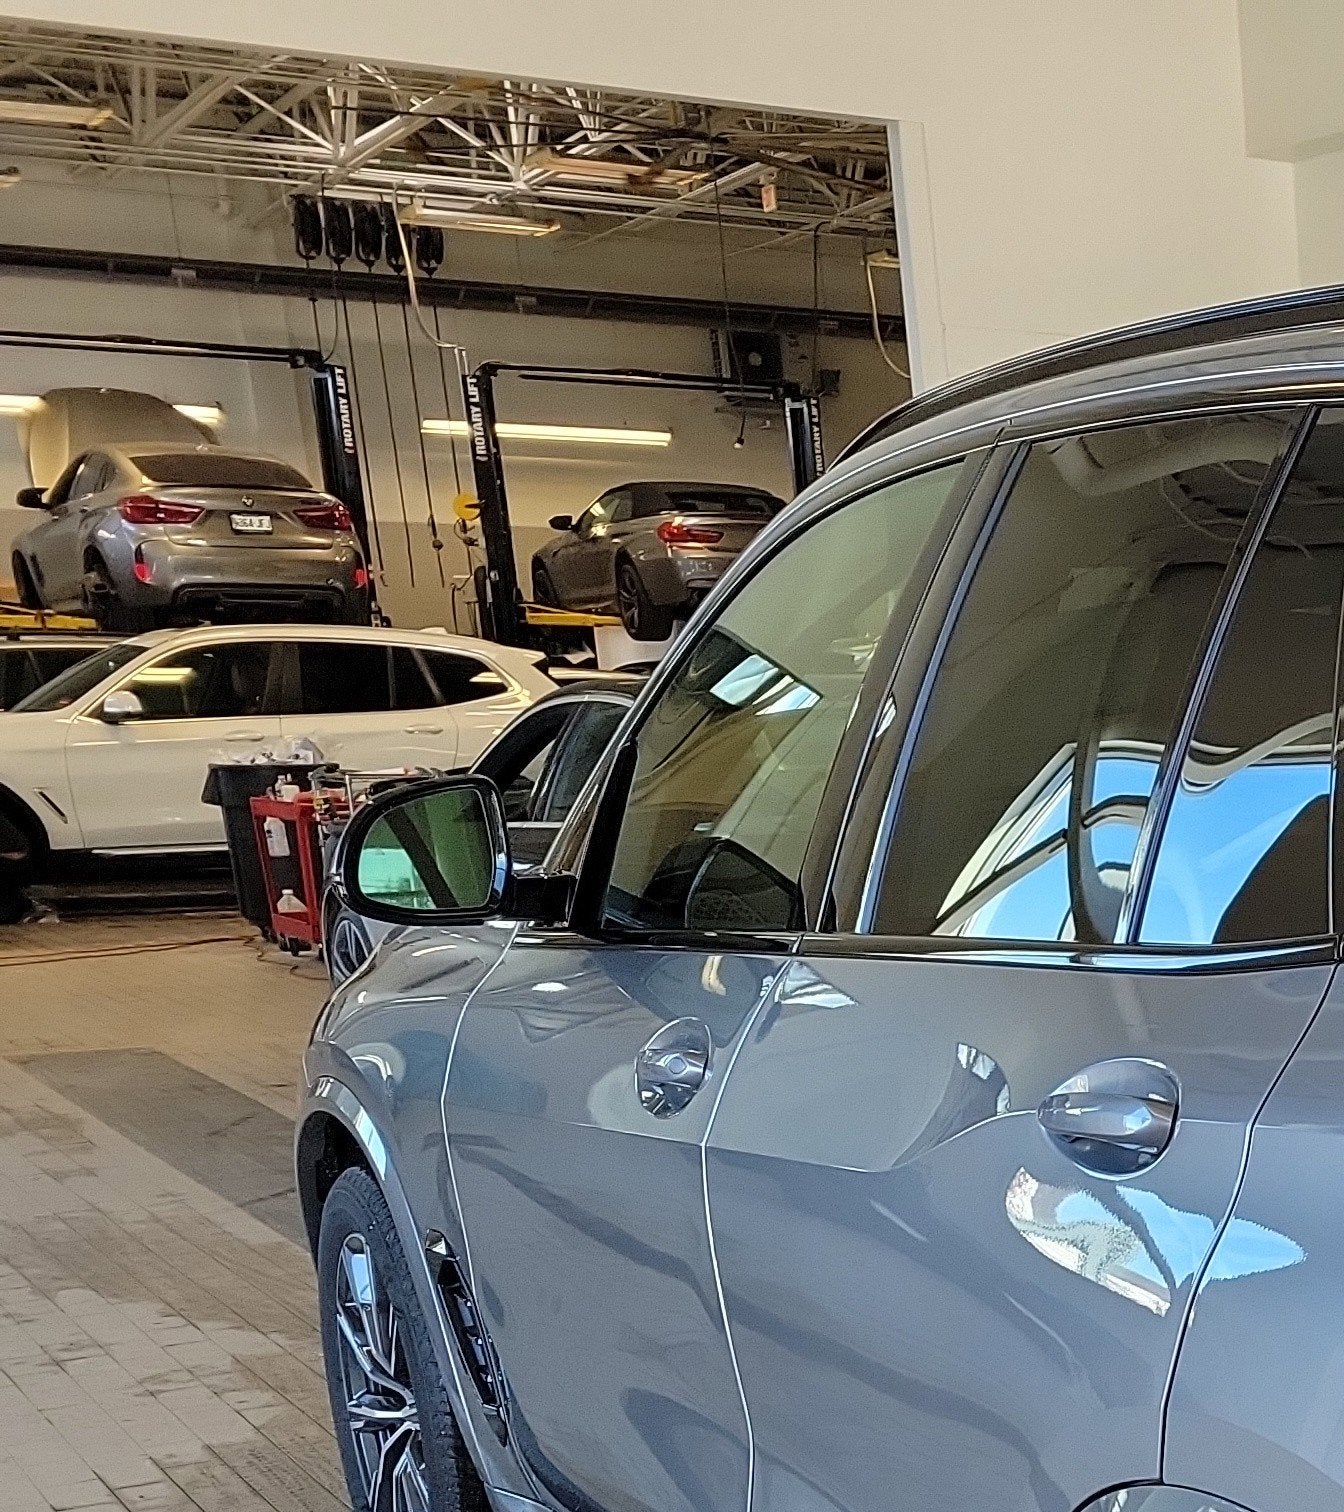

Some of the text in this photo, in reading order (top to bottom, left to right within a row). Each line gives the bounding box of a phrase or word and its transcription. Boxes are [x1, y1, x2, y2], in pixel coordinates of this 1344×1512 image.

[334, 366, 355, 448] ROTARY LIFT
[466, 375, 488, 455] ROTARY LIFT
